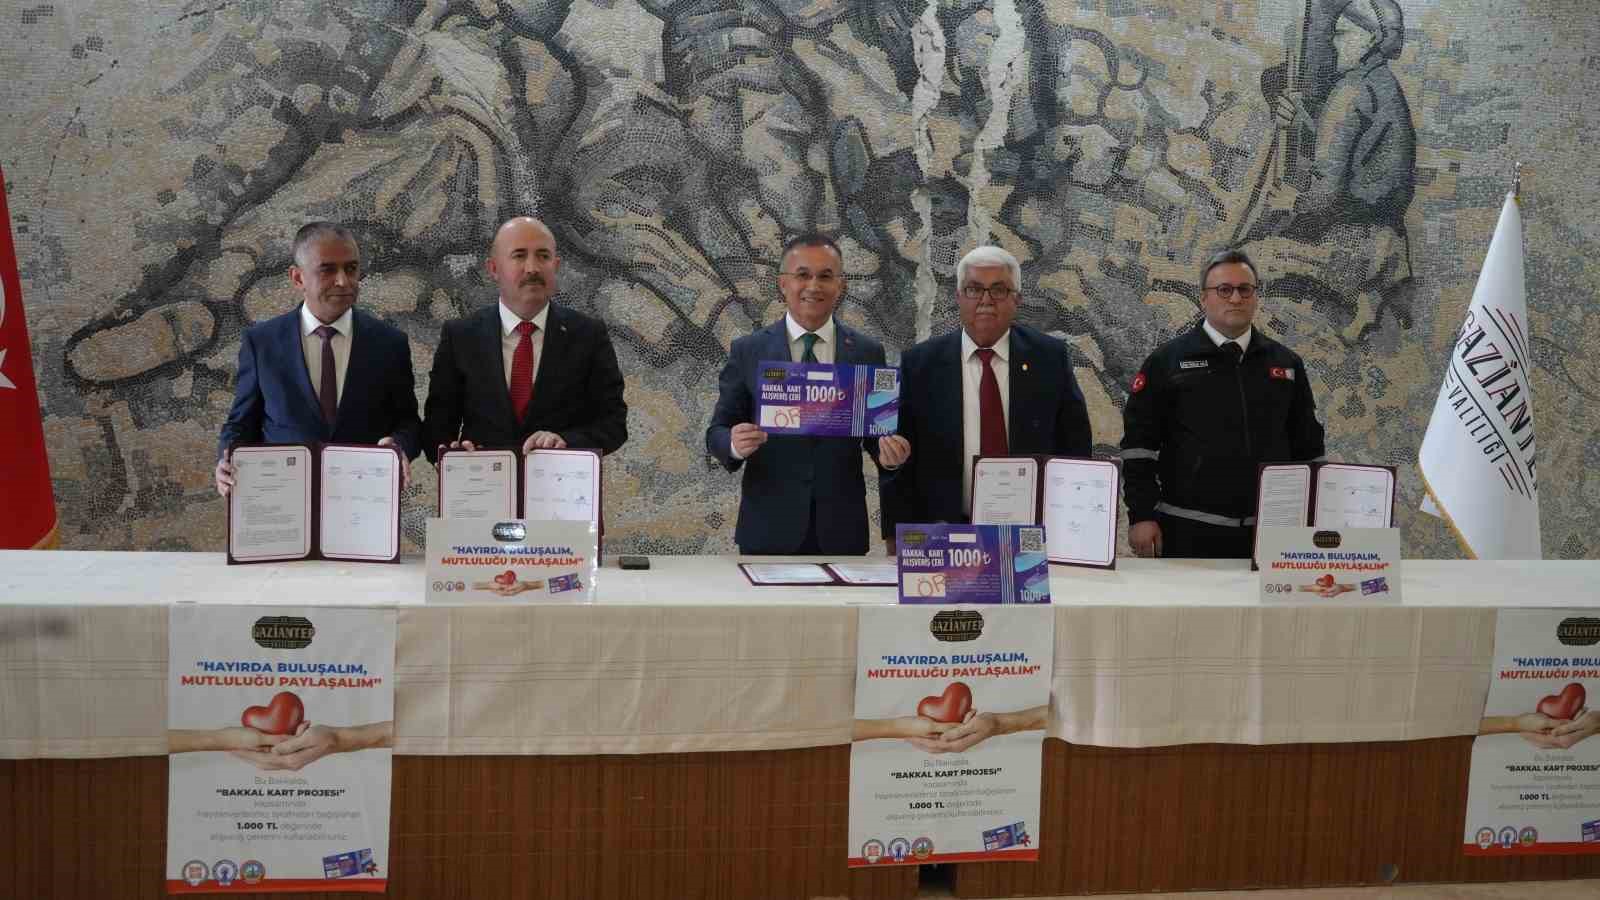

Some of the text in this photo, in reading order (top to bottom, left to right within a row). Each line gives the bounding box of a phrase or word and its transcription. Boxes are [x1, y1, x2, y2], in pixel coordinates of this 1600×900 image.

[1448, 385, 1509, 464] VALİLİĞİ
[441, 556, 507, 566] MUTLULUĞU
[1272, 560, 1327, 570] MUTLULUĞU
[951, 652, 1028, 666] BULUŞALIM,
[277, 662, 368, 675] BULUŞALIM,
[867, 666, 949, 679] MUTLULUĞU
[1500, 667, 1569, 680] MUTLULUĞU
[181, 675, 275, 688] MUTLULUĞU
[935, 770, 959, 778] KART
[267, 789, 296, 797] KART
[909, 802, 932, 810] 1.000
[236, 822, 264, 830] 1.000
[267, 822, 278, 830] TL
